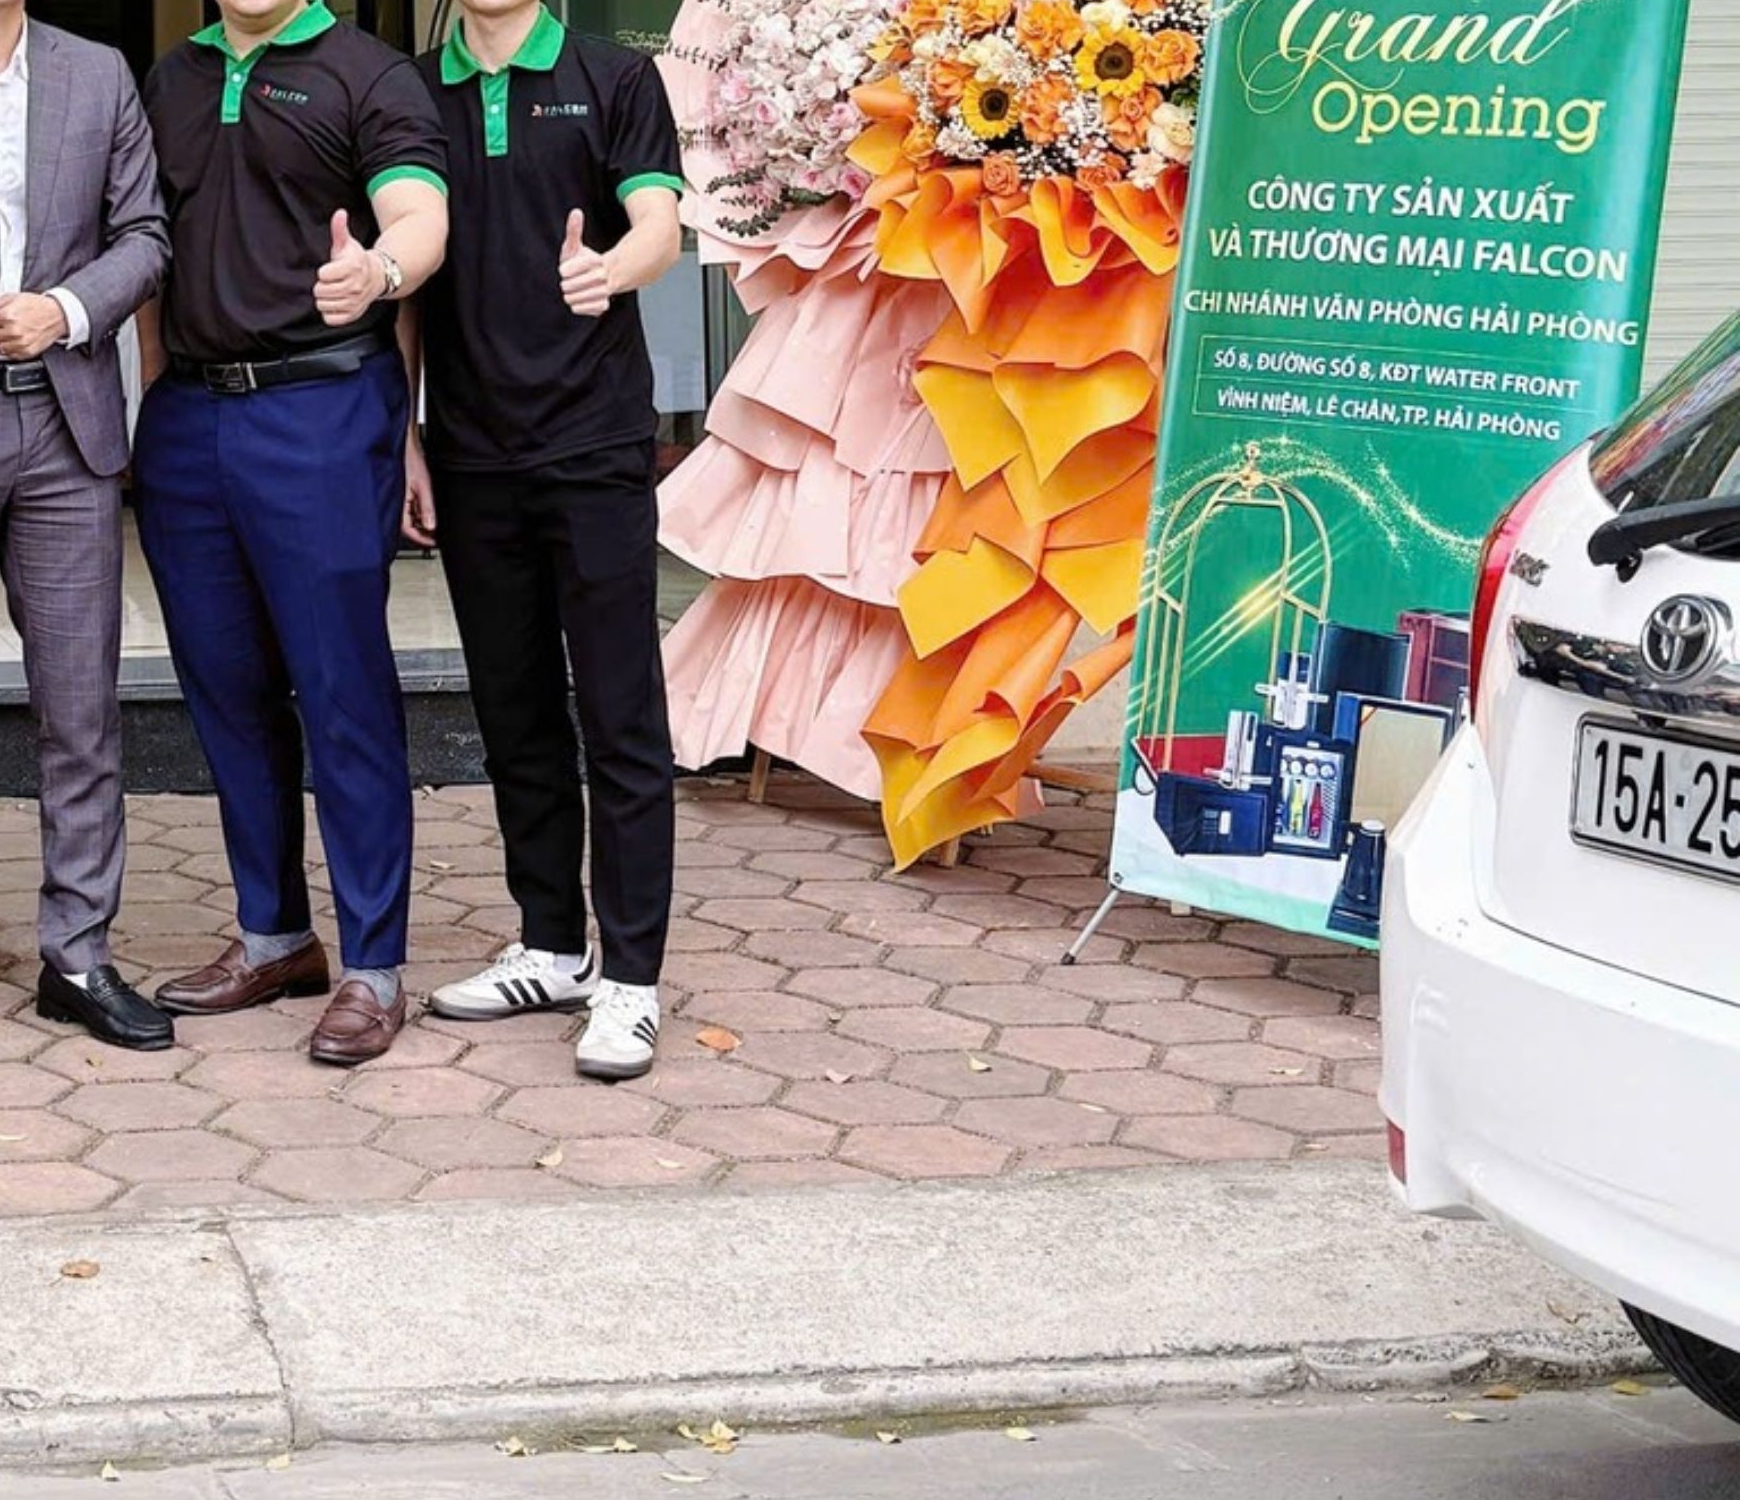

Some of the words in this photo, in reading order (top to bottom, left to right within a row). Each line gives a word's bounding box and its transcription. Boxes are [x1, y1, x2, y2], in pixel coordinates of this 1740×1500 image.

[1312, 81, 1606, 153] Opening
[1247, 174, 1336, 212] CÔNG
[1342, 183, 1387, 215] TY
[1391, 176, 1465, 218] SẢN
[1470, 180, 1576, 224] XUẤT
[1209, 222, 1243, 258] VÀ
[1249, 226, 1389, 265] THƯƠNG
[1395, 235, 1465, 278] MẠI
[1472, 239, 1629, 283] FALCON
[1184, 289, 1223, 314] CHI
[1225, 288, 1309, 318] NHÁNH
[1312, 292, 1364, 322] VĂN
[1367, 297, 1464, 330] PHÒNG
[1469, 301, 1521, 335] HẢI
[1526, 310, 1640, 346] PHÒNG
[1238, 353, 1252, 372] 8,
[1358, 361, 1376, 382] 8,
[1379, 362, 1422, 384] KĐT
[1424, 366, 1497, 392] WATER
[1500, 373, 1581, 400] FRONT
[1315, 394, 1339, 417] LÊ
[1433, 405, 1472, 430] HẢI
[1476, 412, 1562, 441] PHÒNG
